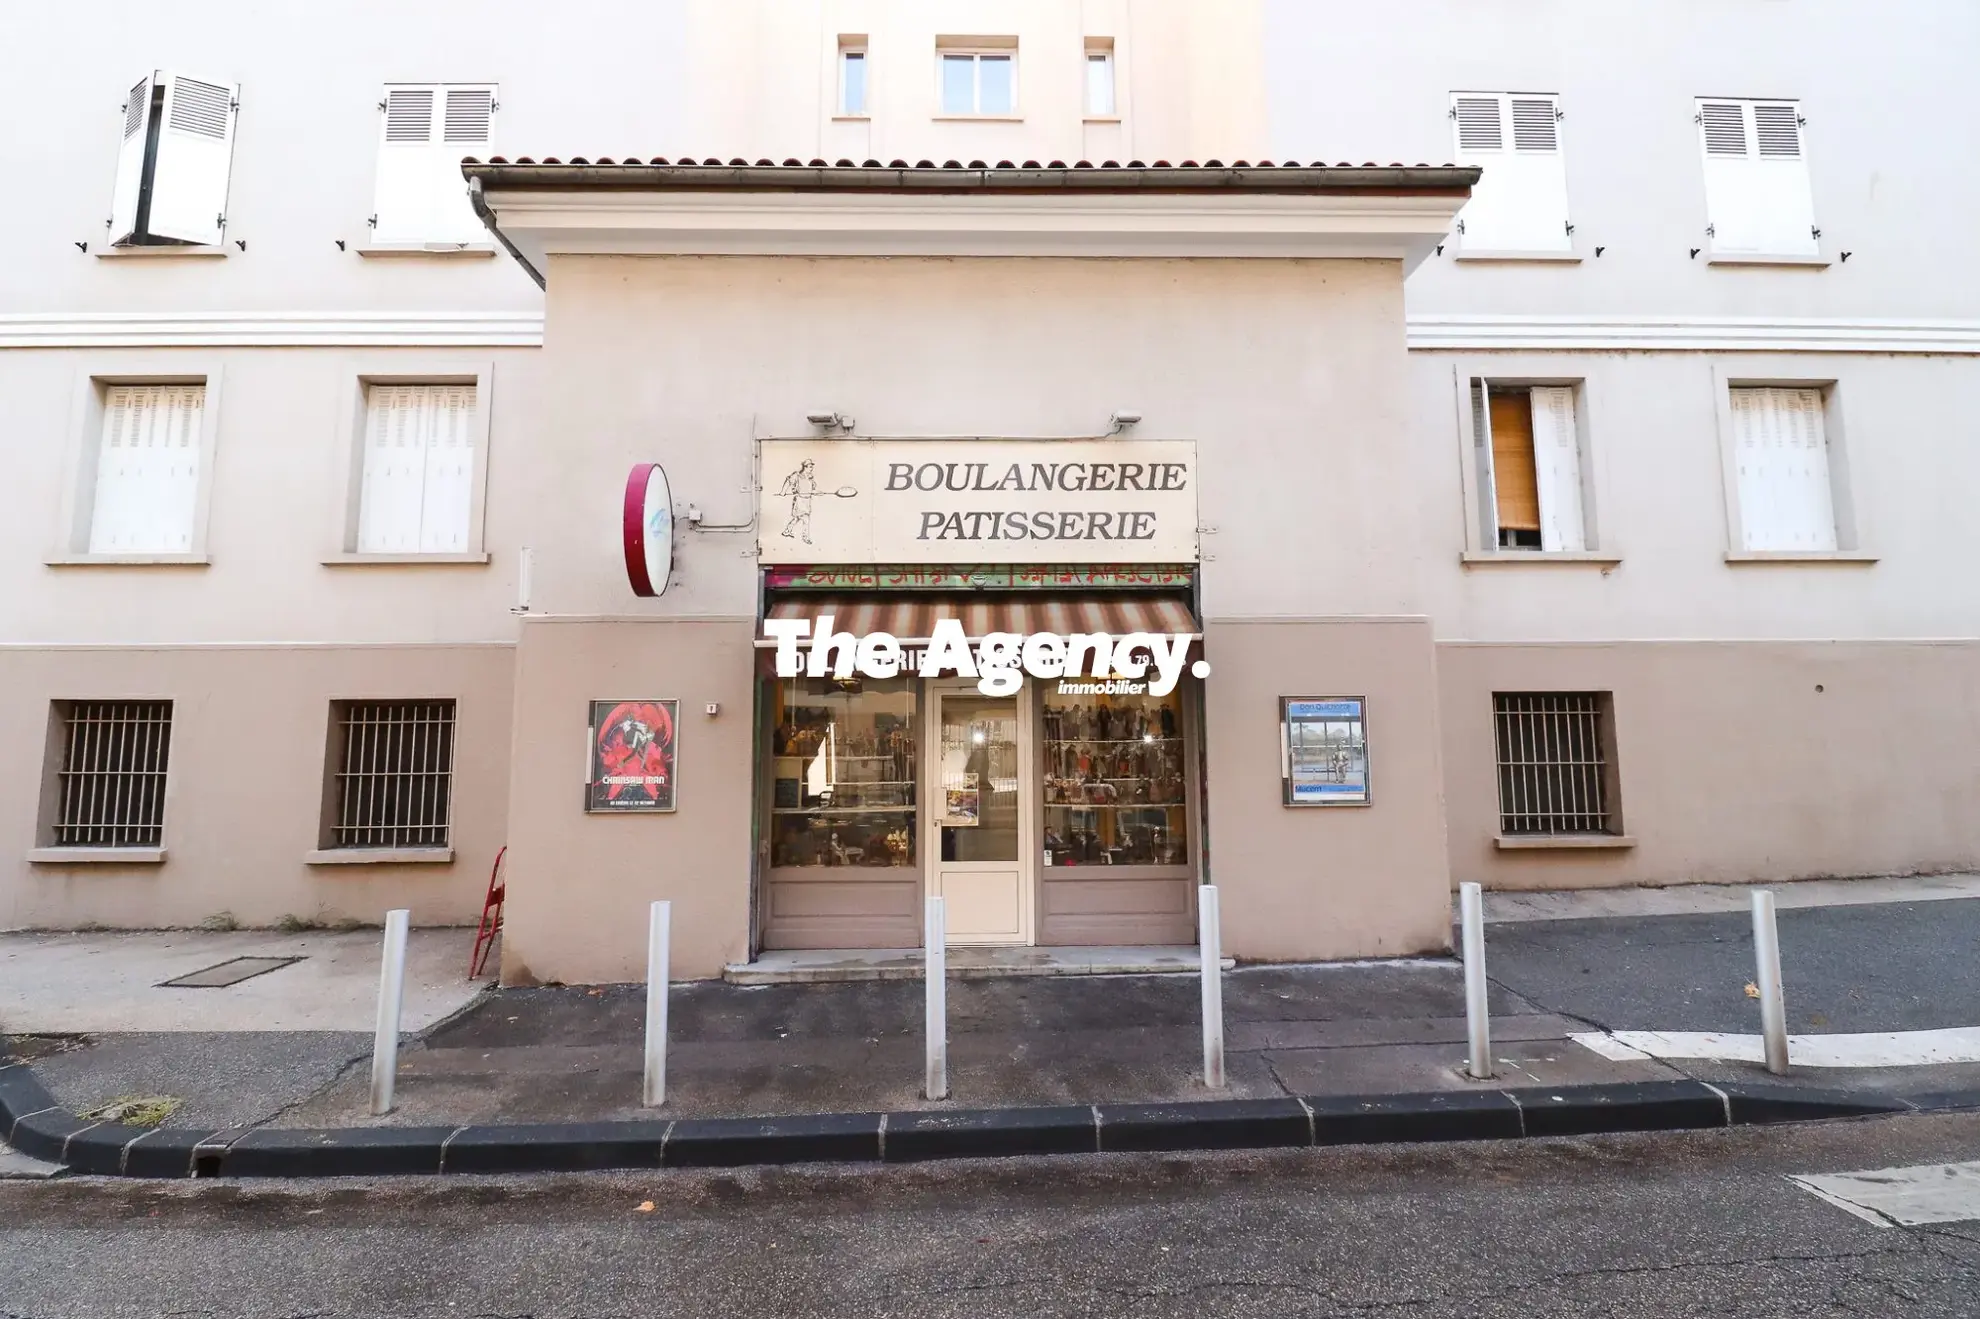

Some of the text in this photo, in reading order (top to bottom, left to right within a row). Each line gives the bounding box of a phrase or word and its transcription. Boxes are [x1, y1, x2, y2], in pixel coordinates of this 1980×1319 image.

[884, 463, 1187, 491] BOULANGERIE
[916, 511, 1157, 540] PATISSERIE
[645, 775, 665, 785] MAN
[1295, 784, 1322, 793] Mucem
